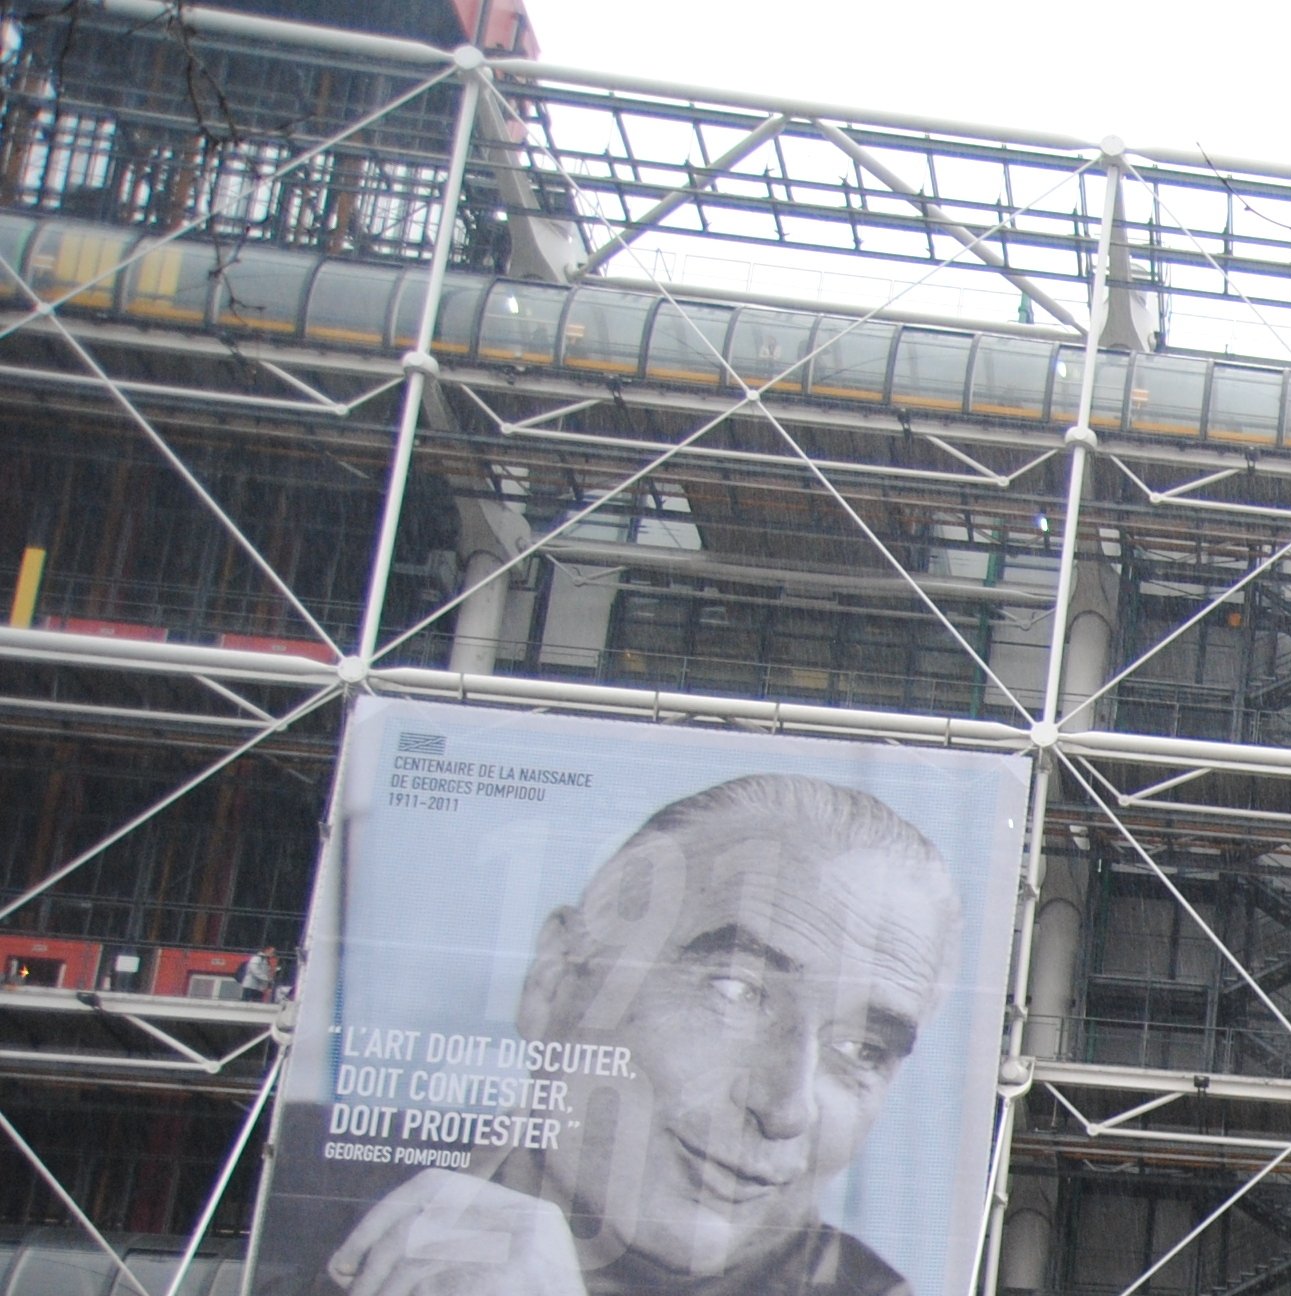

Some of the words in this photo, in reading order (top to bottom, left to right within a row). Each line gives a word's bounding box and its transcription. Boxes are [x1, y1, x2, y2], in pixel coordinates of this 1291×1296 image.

[391, 774, 408, 789] DE
[412, 776, 472, 795] GEORGES
[476, 782, 547, 802] POMPIDOU
[394, 756, 475, 777] CENTENAIRE
[478, 764, 496, 779] DE
[500, 766, 515, 781] LA
[519, 767, 594, 788] NAISSANCE
[426, 1033, 492, 1067] DOIT
[497, 1038, 637, 1080] DISCUTER,
[337, 1064, 404, 1098] DOIT
[410, 1070, 573, 1114] CONTESTER,
[329, 1103, 398, 1136] DOIT
[324, 1142, 392, 1163] GEORGES
[394, 1147, 472, 1168] POMPIDOU
